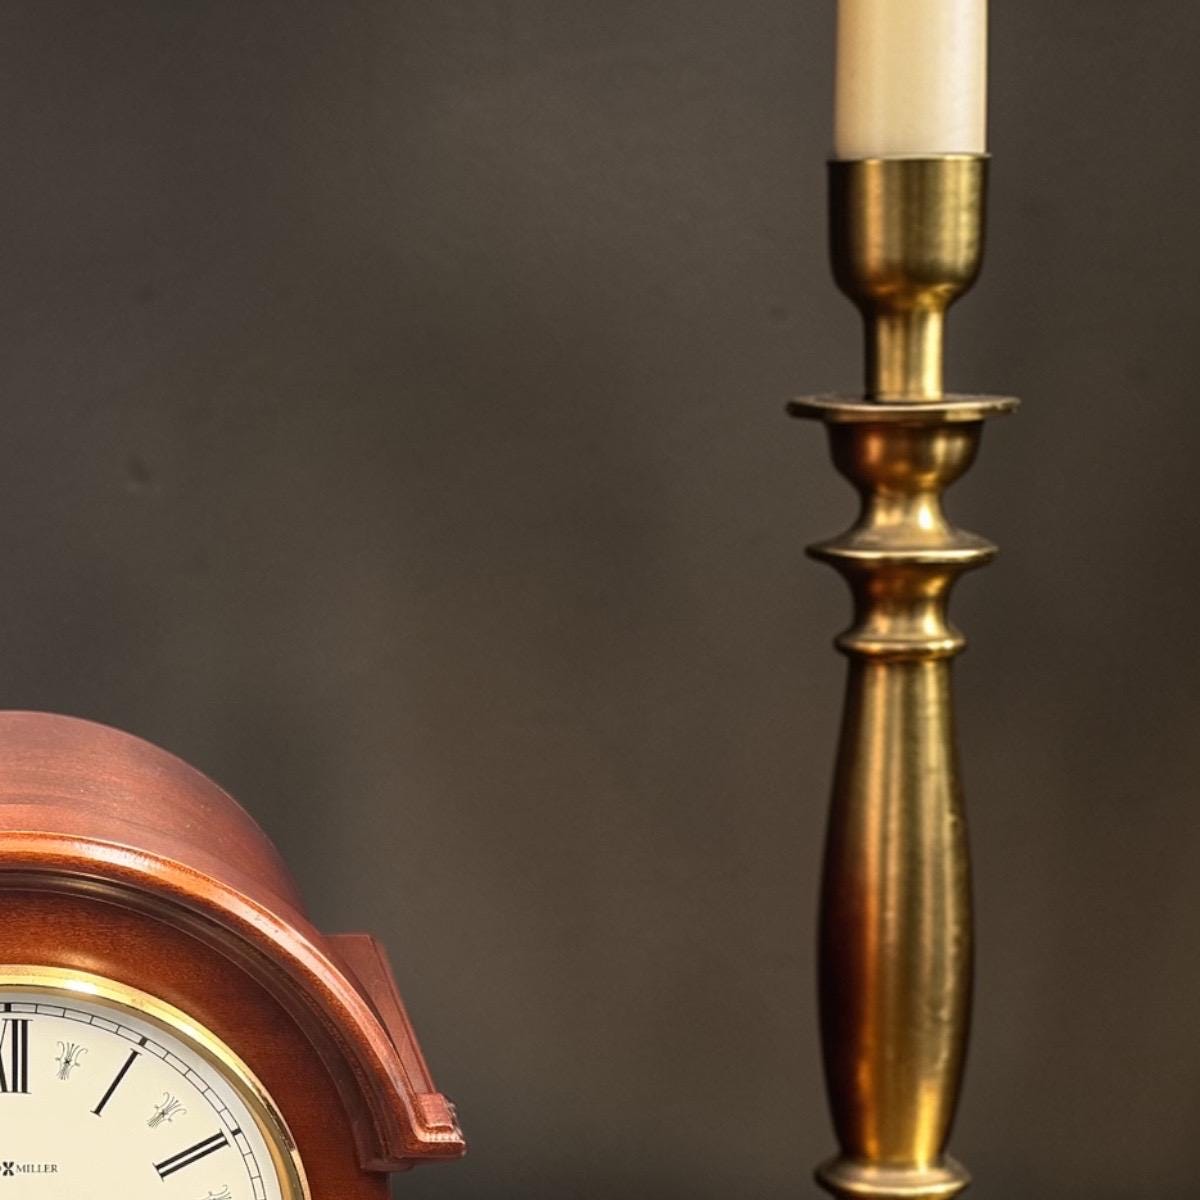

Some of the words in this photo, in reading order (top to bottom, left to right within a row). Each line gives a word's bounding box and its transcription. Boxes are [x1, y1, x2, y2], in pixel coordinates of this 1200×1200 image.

[90, 1048, 142, 1117] I
[16, 1163, 59, 1174] MILLER
[152, 1128, 231, 1182] II
